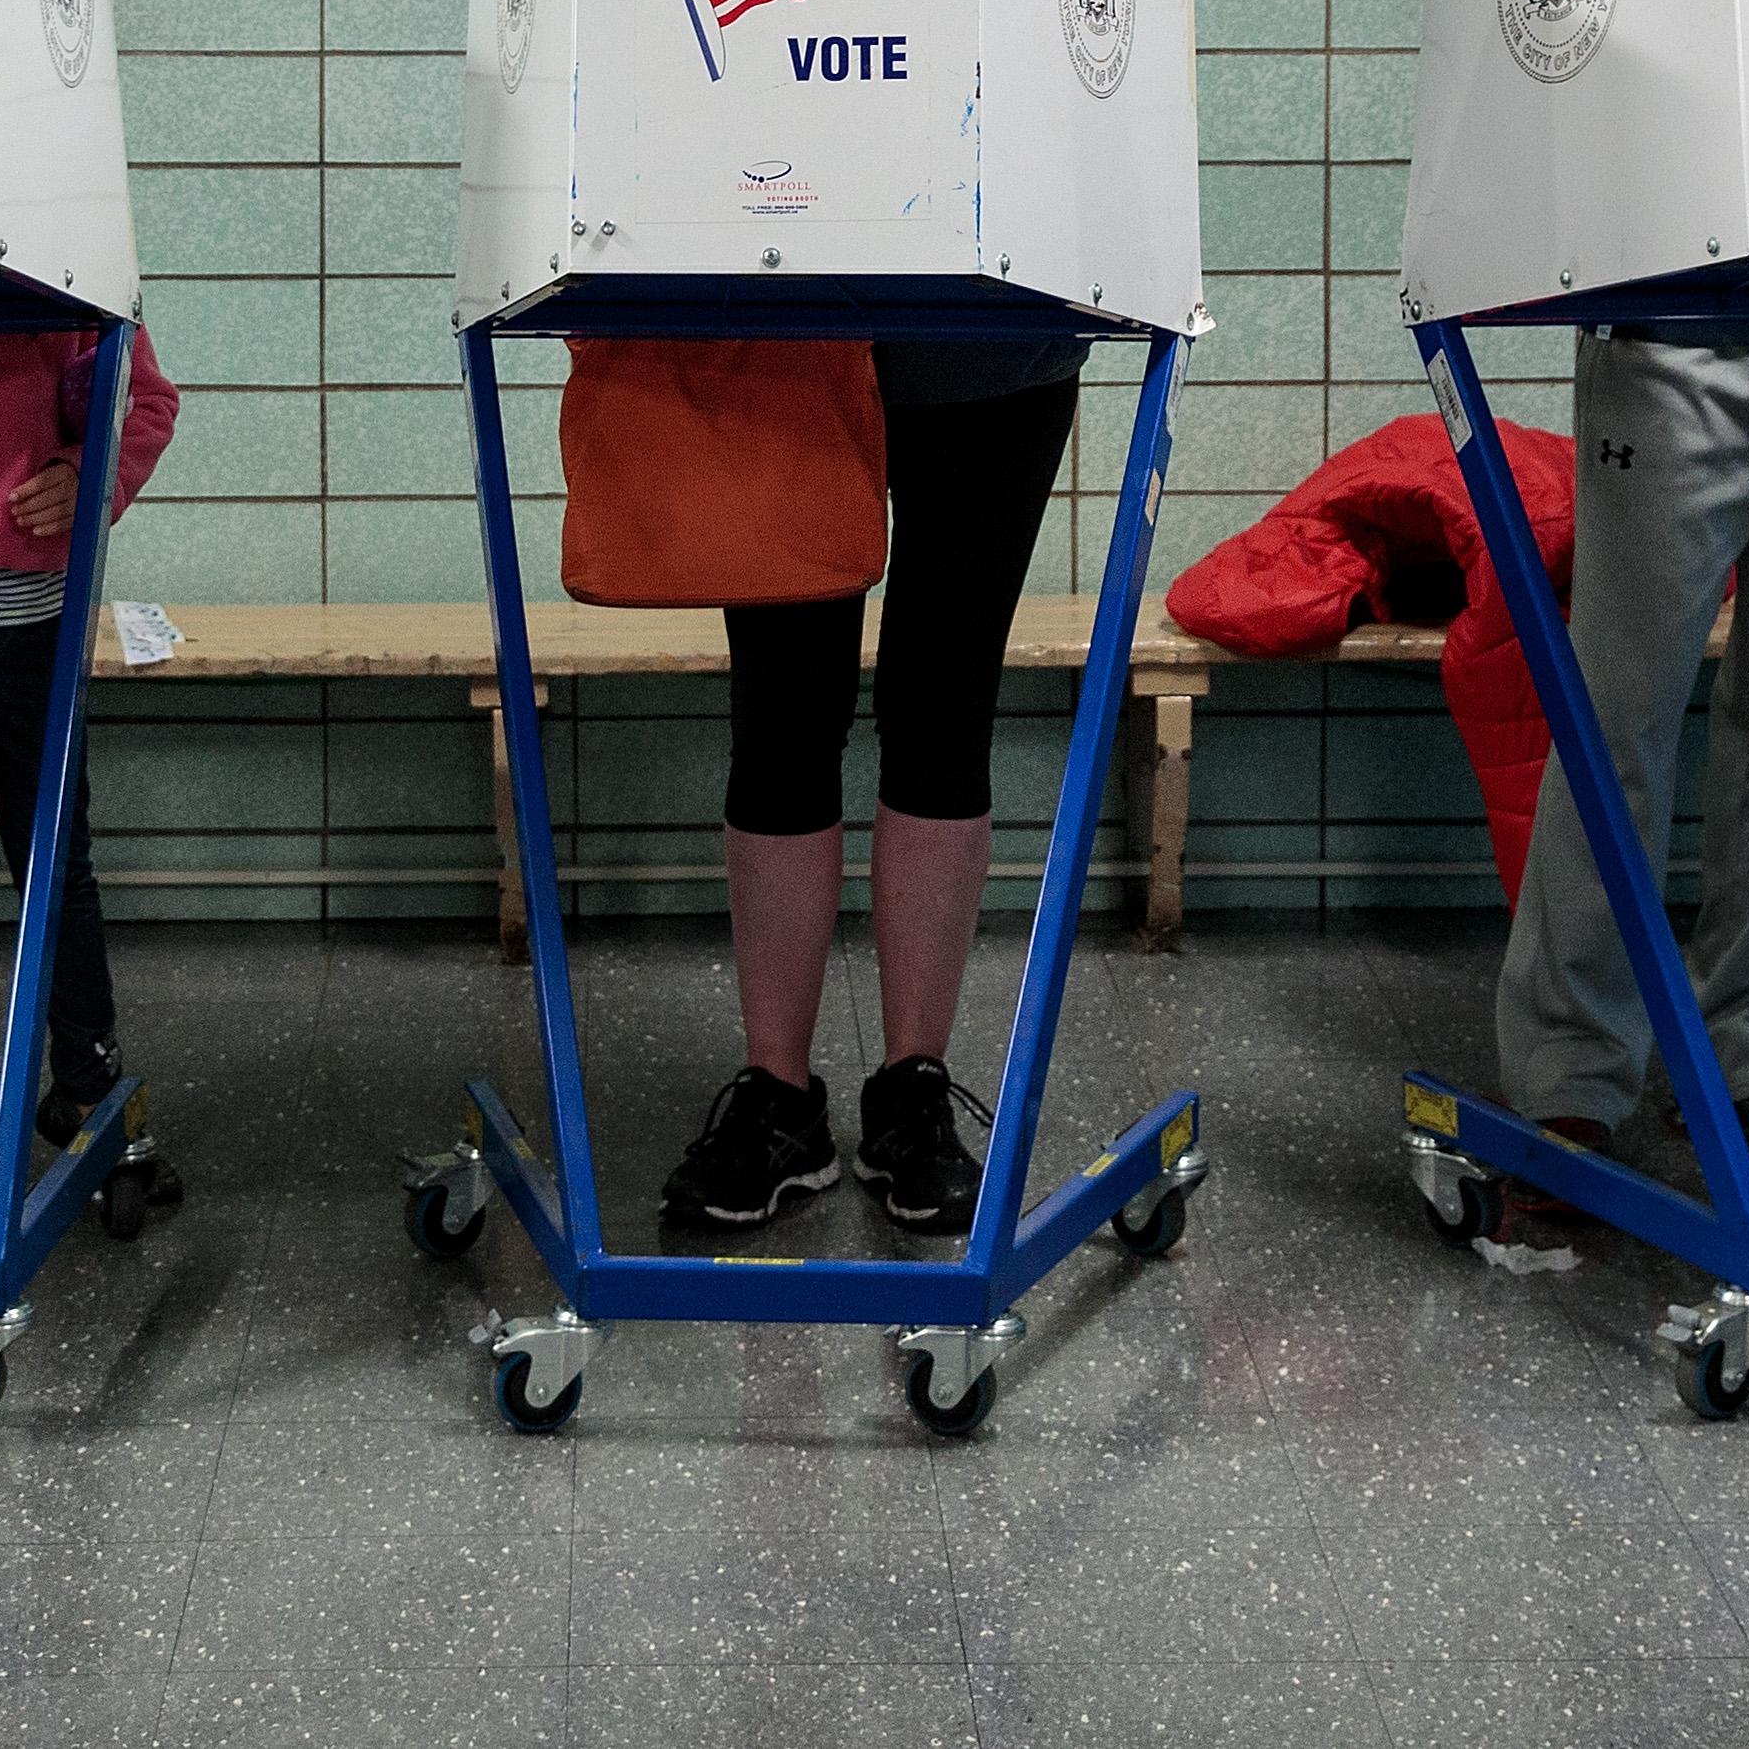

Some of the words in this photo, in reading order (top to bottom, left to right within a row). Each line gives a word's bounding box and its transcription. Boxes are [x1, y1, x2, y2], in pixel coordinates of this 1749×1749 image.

[786, 35, 908, 82] VOTE
[1504, 4, 1524, 47] THE
[1522, 41, 1553, 72] CITY
[1553, 51, 1571, 72] OF
[1575, 18, 1602, 62] NEW
[737, 181, 812, 192] SMARTPOLL
